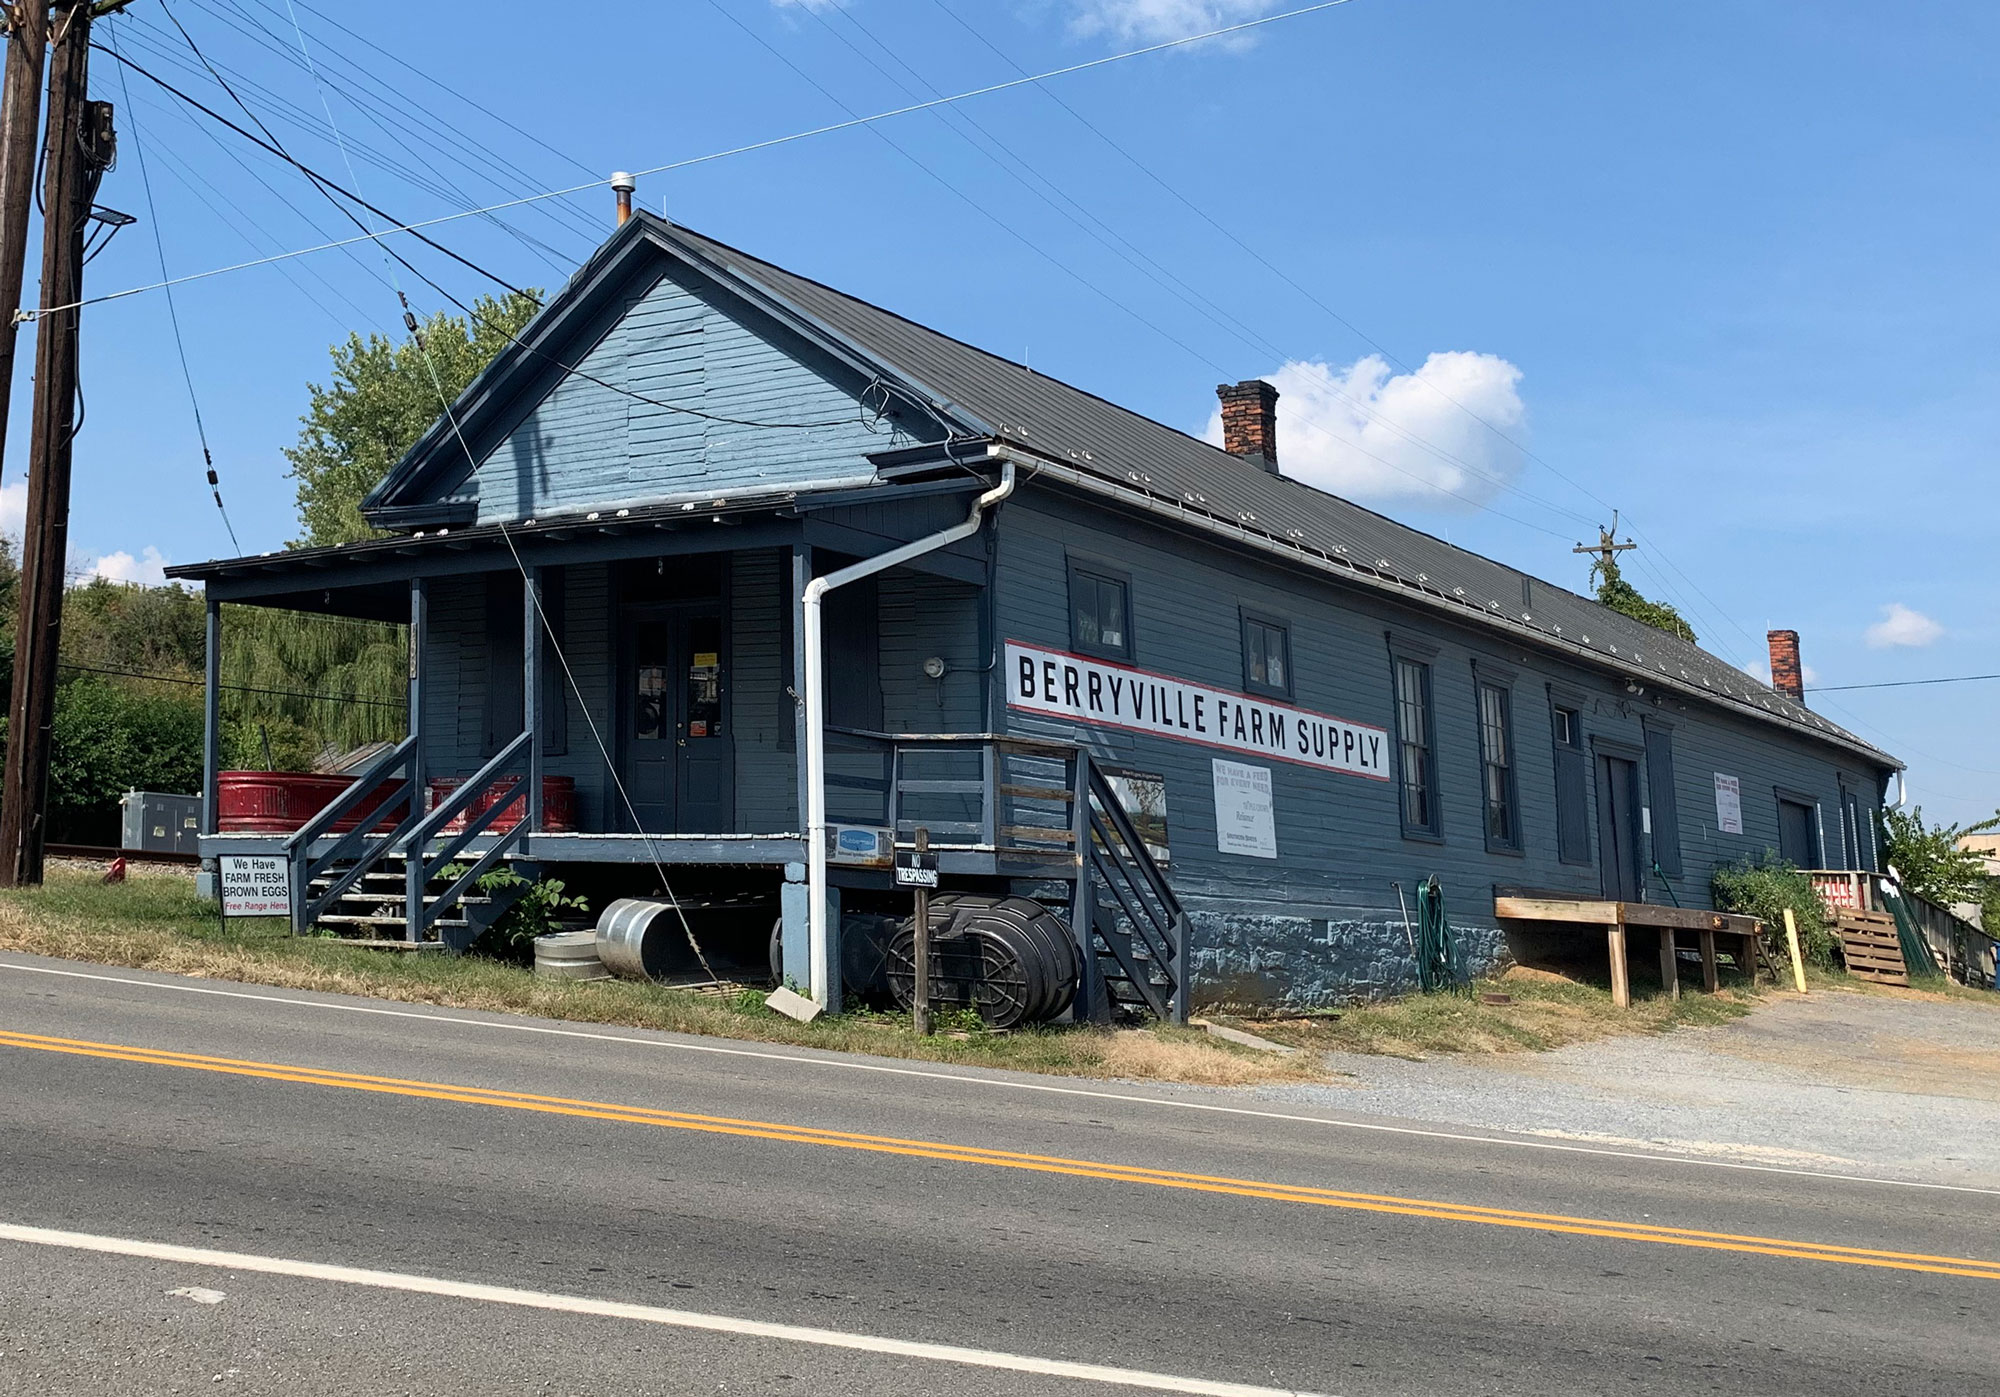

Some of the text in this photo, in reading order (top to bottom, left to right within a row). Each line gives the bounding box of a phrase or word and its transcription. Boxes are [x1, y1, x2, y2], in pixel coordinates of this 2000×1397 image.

[1019, 655, 1379, 769] BERRYVILLE FARM SUPPLY
[1215, 762, 1269, 782] WE HAVE A FEED
[1216, 775, 1229, 786] FOR
[1230, 778, 1251, 789] EVERY
[233, 858, 276, 869] We Have
[911, 854, 921, 868] NO
[225, 872, 285, 883] FARM FRESH
[897, 867, 938, 883] TRESPASSING
[223, 886, 288, 897] BROWN EGGS
[225, 901, 288, 911] Free Range Hens
